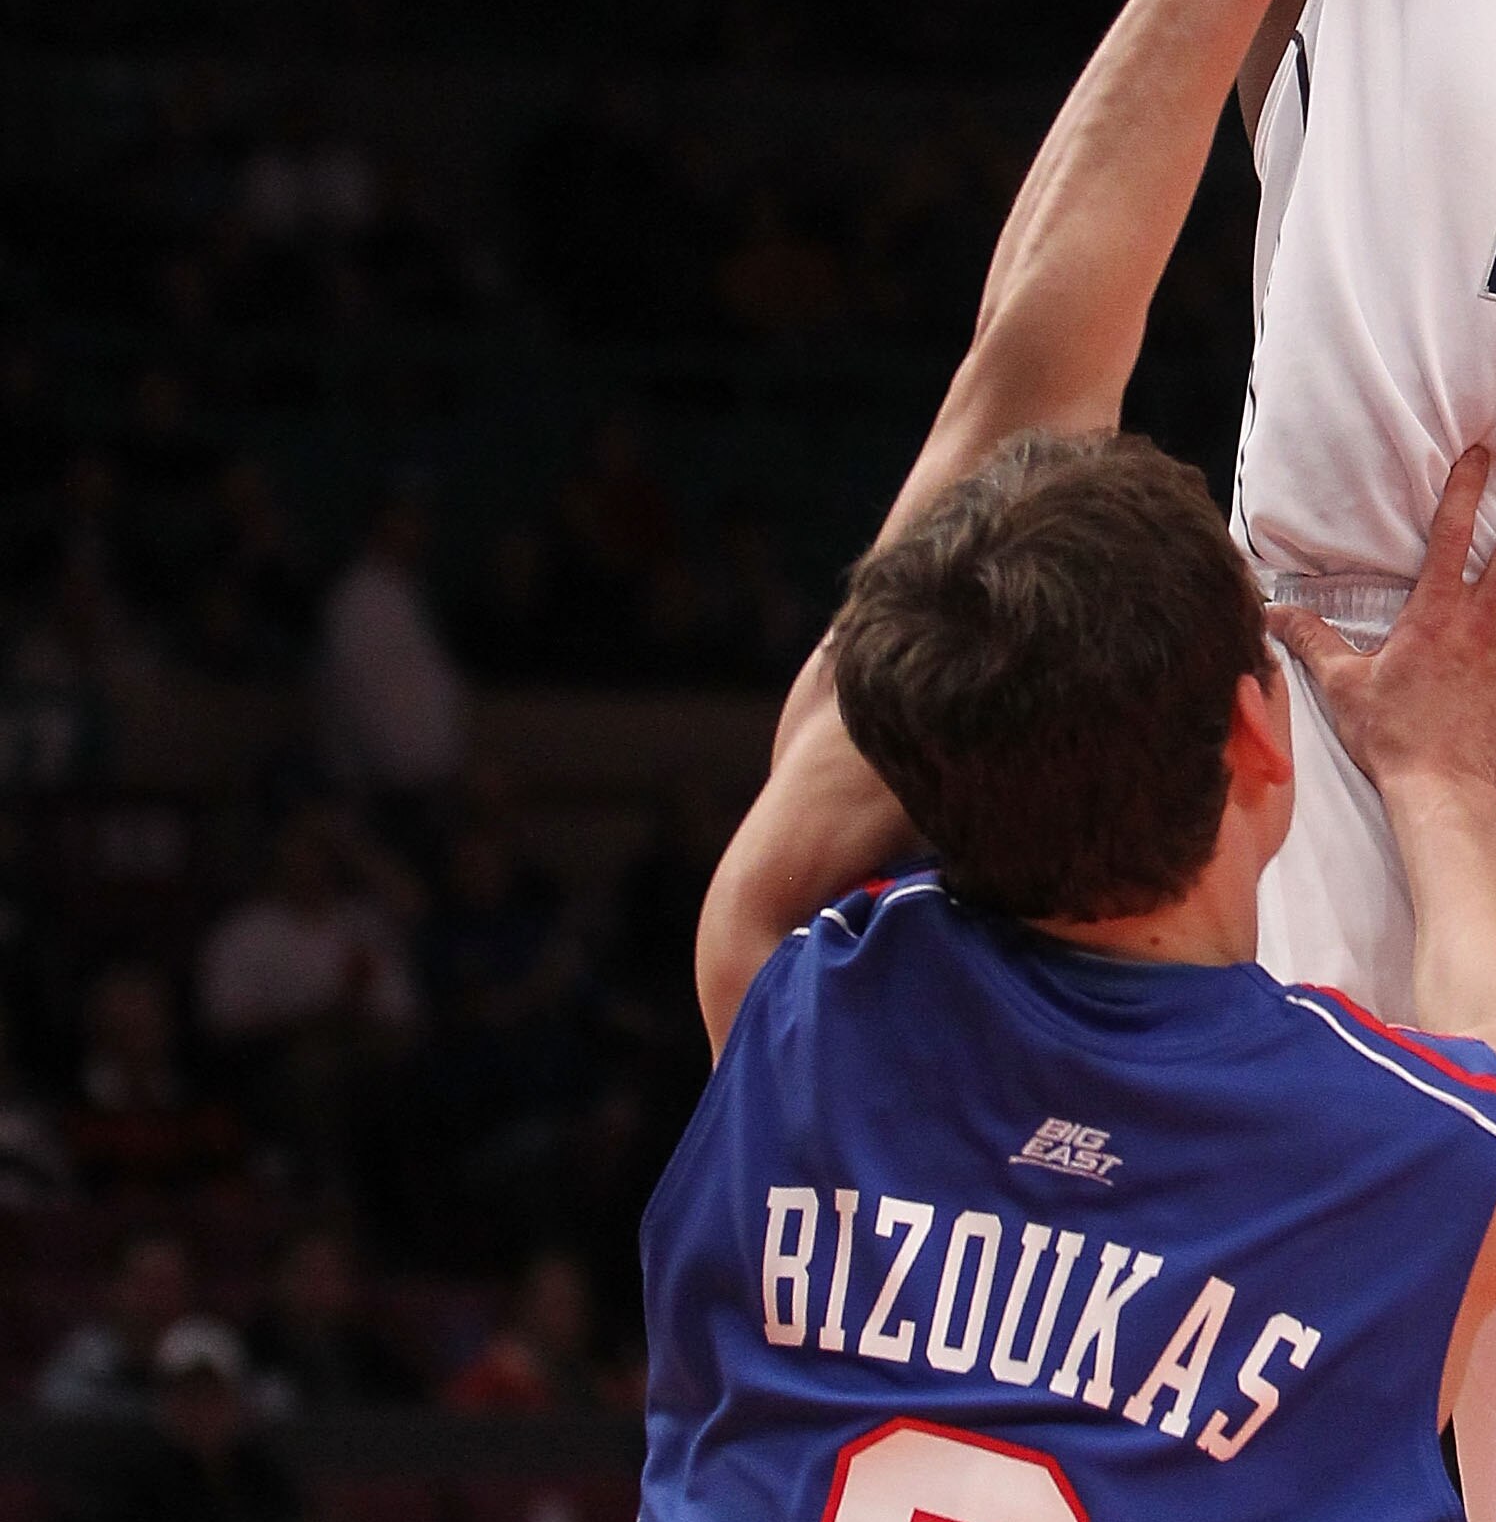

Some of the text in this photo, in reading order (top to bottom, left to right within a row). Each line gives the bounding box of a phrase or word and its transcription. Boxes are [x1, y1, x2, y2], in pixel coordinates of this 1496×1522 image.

[1036, 1117, 1110, 1150] BIG
[1022, 1137, 1123, 1176] EAST
[763, 1186, 1322, 1463] BIZOUKAS
